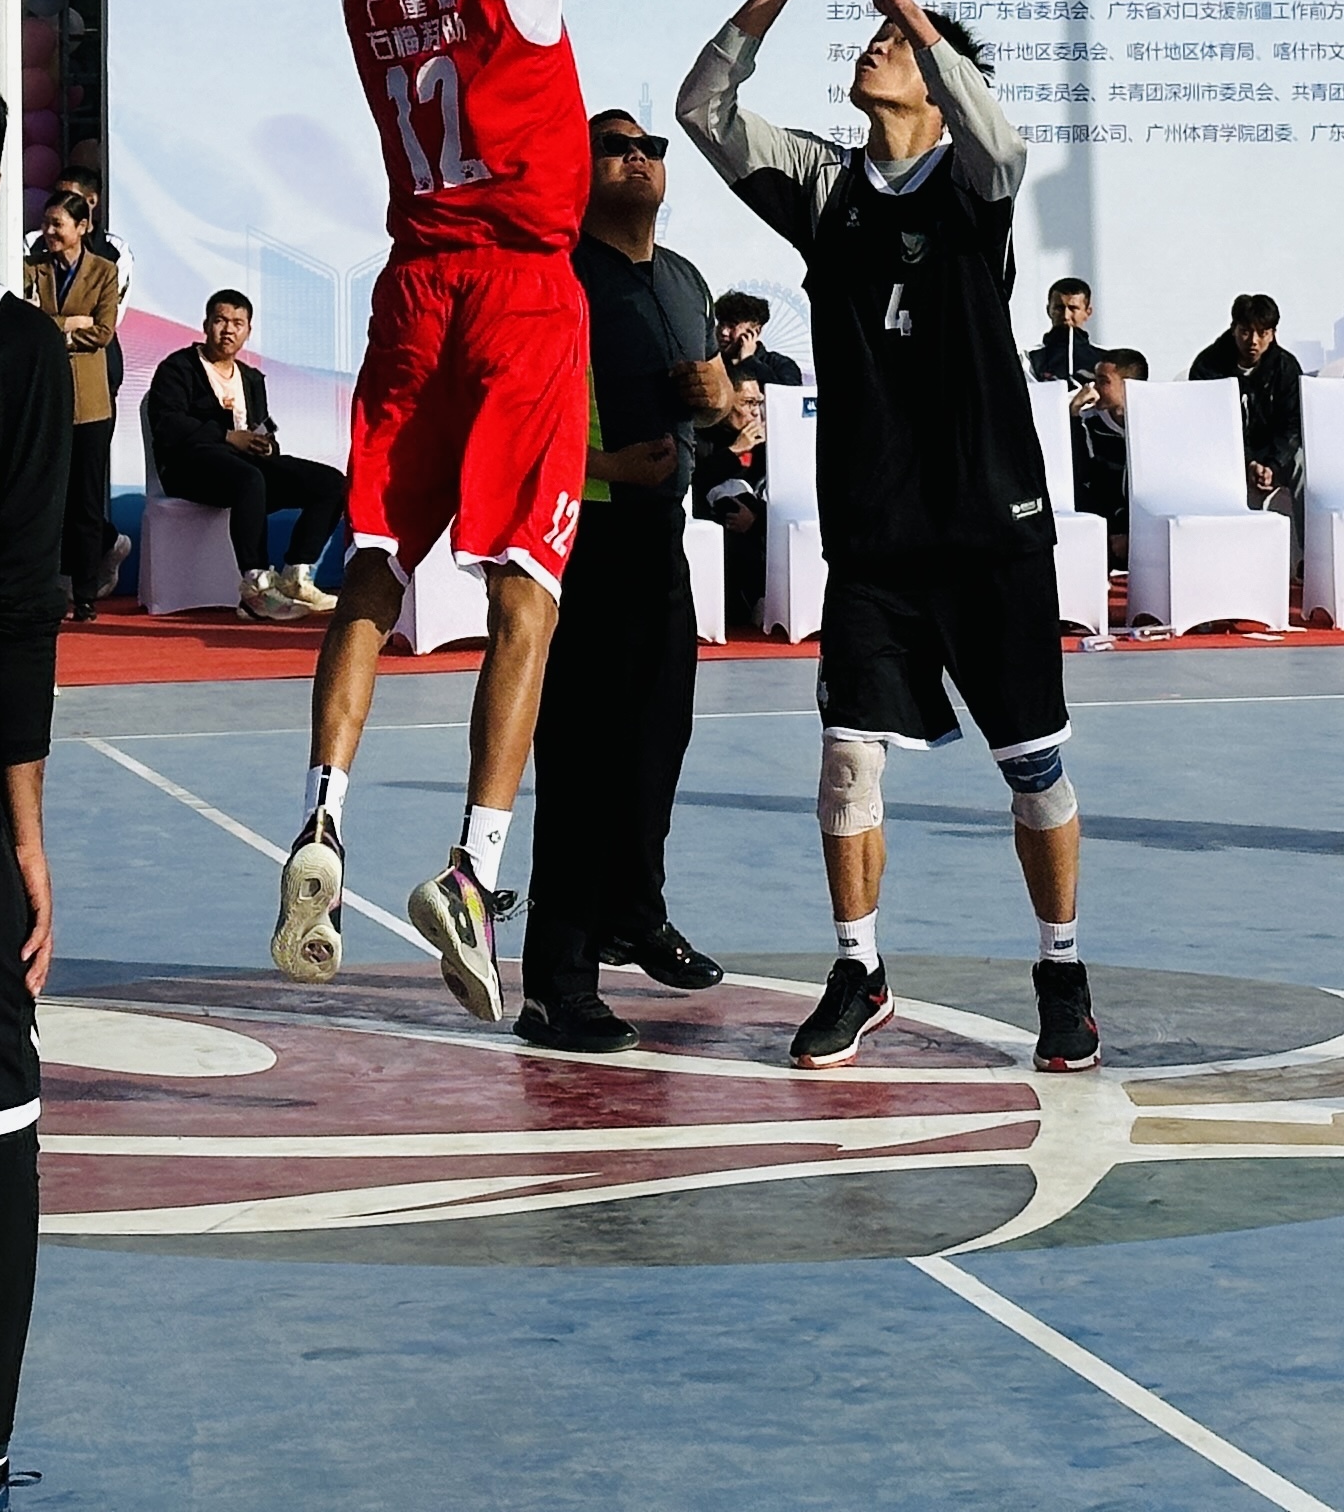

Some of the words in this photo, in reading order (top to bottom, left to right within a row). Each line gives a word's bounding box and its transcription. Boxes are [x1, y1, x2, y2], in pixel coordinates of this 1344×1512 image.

[386, 55, 493, 196] 12
[884, 283, 913, 337] 4
[543, 490, 581, 557] 12
